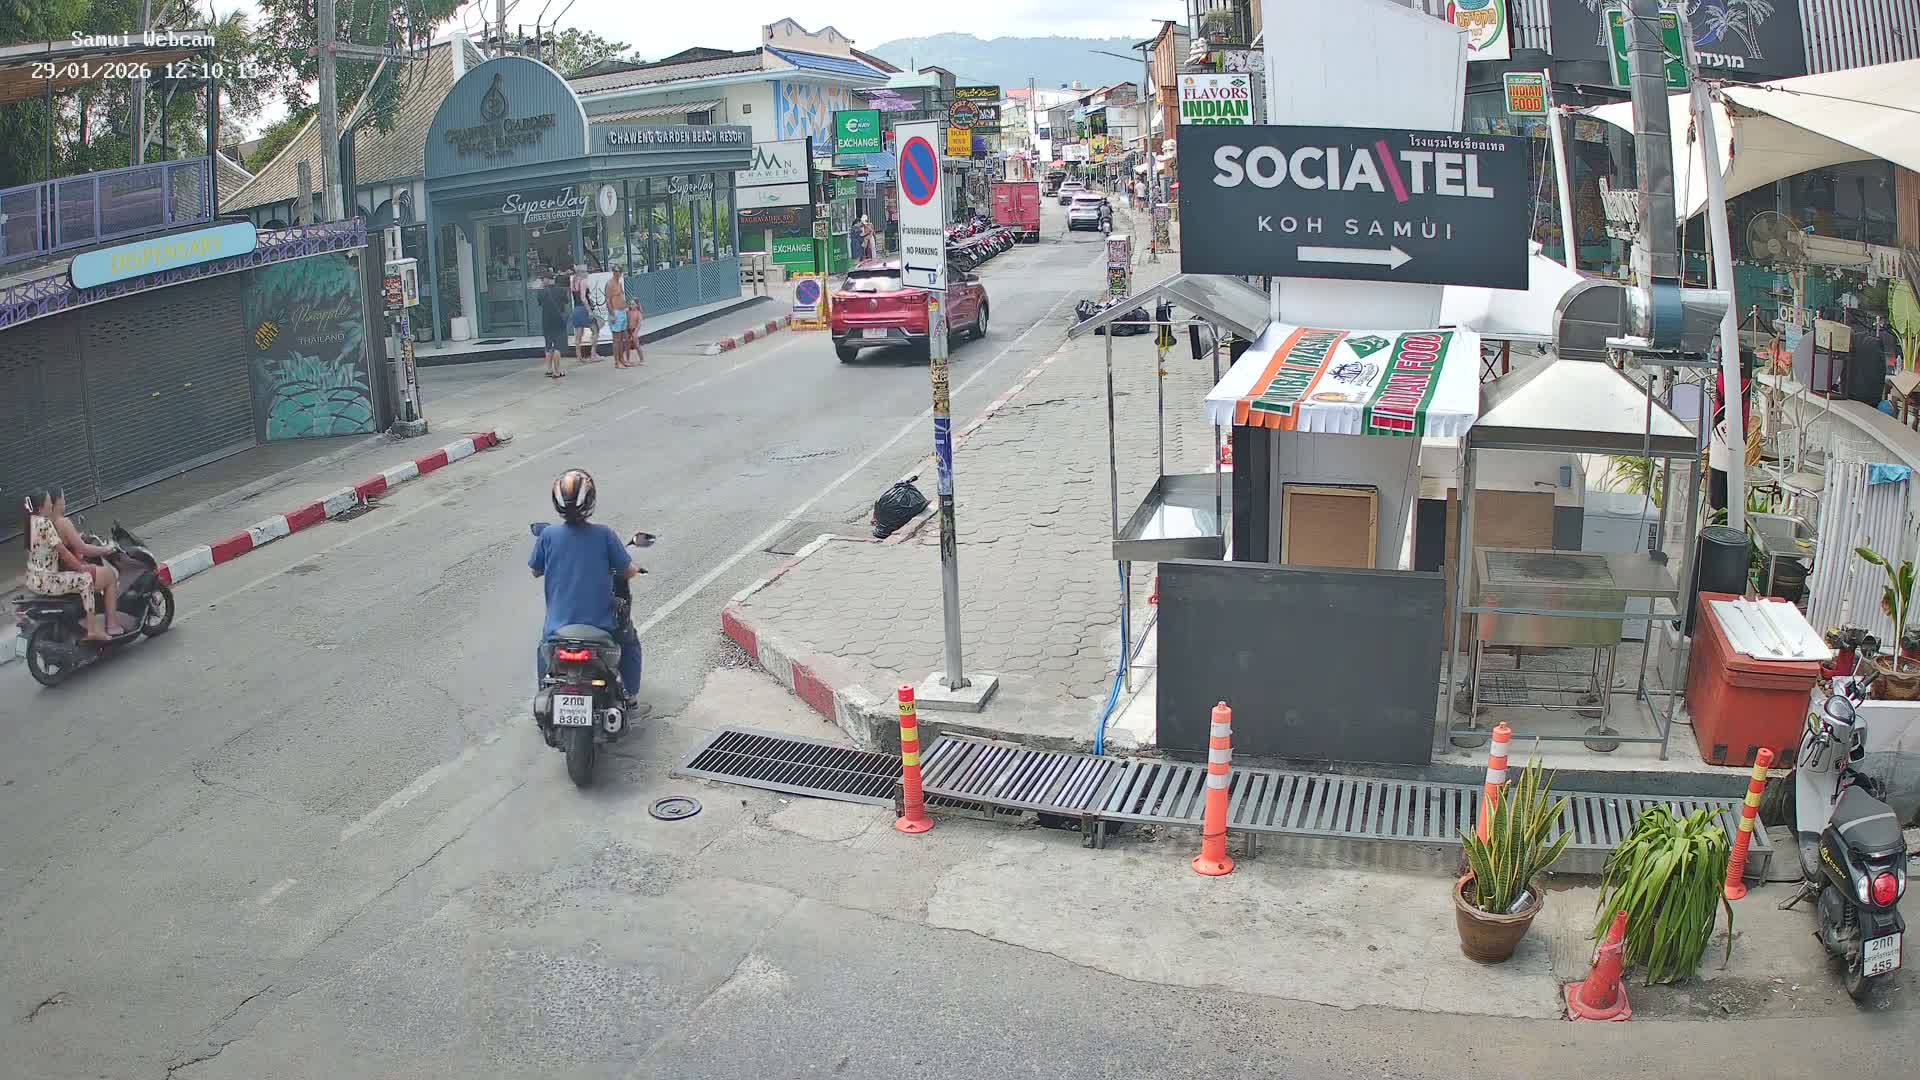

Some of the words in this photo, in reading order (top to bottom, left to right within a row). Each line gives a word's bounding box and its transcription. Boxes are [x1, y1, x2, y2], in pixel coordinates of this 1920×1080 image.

[1183, 88, 1249, 99] FLAVORS
[1508, 84, 1542, 97] INDIAN
[1183, 100, 1249, 117] INDIAN
[1512, 98, 1541, 111] FOOD
[611, 131, 654, 144] CHAWENG
[656, 131, 690, 143] GARDEN
[693, 131, 717, 143] BEACH
[719, 131, 746, 143] RESORT
[839, 138, 878, 147] EXCHANGE
[1257, 215, 1323, 234] KOH
[1345, 218, 1451, 239] SAMUI
[111, 233, 224, 273] DISPENSARY
[773, 243, 811, 253] EXCHANGE
[906, 246, 914, 254] NO
[915, 247, 939, 256] PARKING
[1781, 306, 1810, 327] OPN
[299, 333, 345, 345] THAILAND
[1395, 333, 1442, 371] FOOD
[1370, 373, 1430, 431] INDIAN
[559, 716, 586, 724] 8360
[1872, 959, 1892, 973] 455
